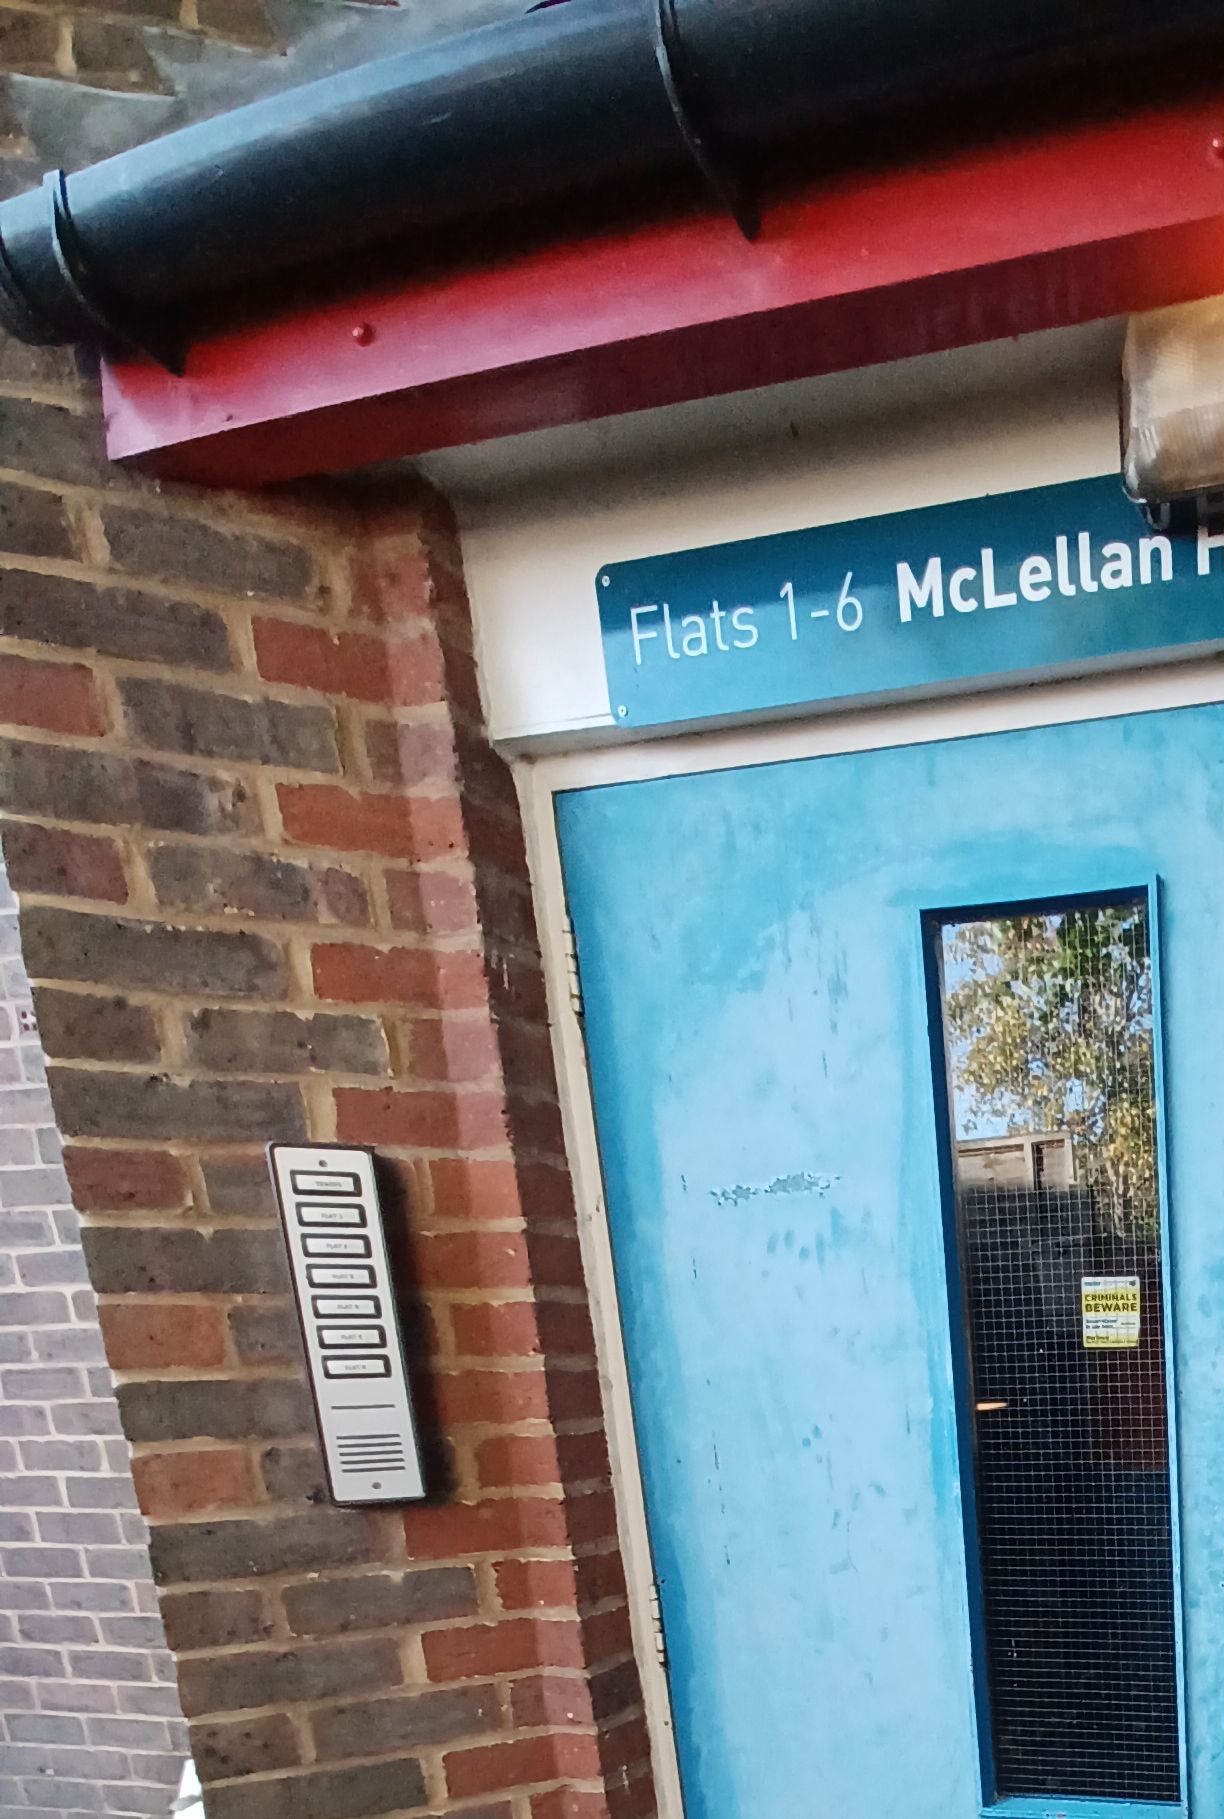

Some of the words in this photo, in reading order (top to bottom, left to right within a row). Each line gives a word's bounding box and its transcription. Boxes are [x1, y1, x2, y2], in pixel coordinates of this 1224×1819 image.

[629, 602, 759, 667] Flats
[780, 571, 864, 640] 1-6
[896, 530, 1173, 623] McLellan
[1084, 1293, 1137, 1302] CRIMINALS
[1085, 1302, 1138, 1313] BEWARE
